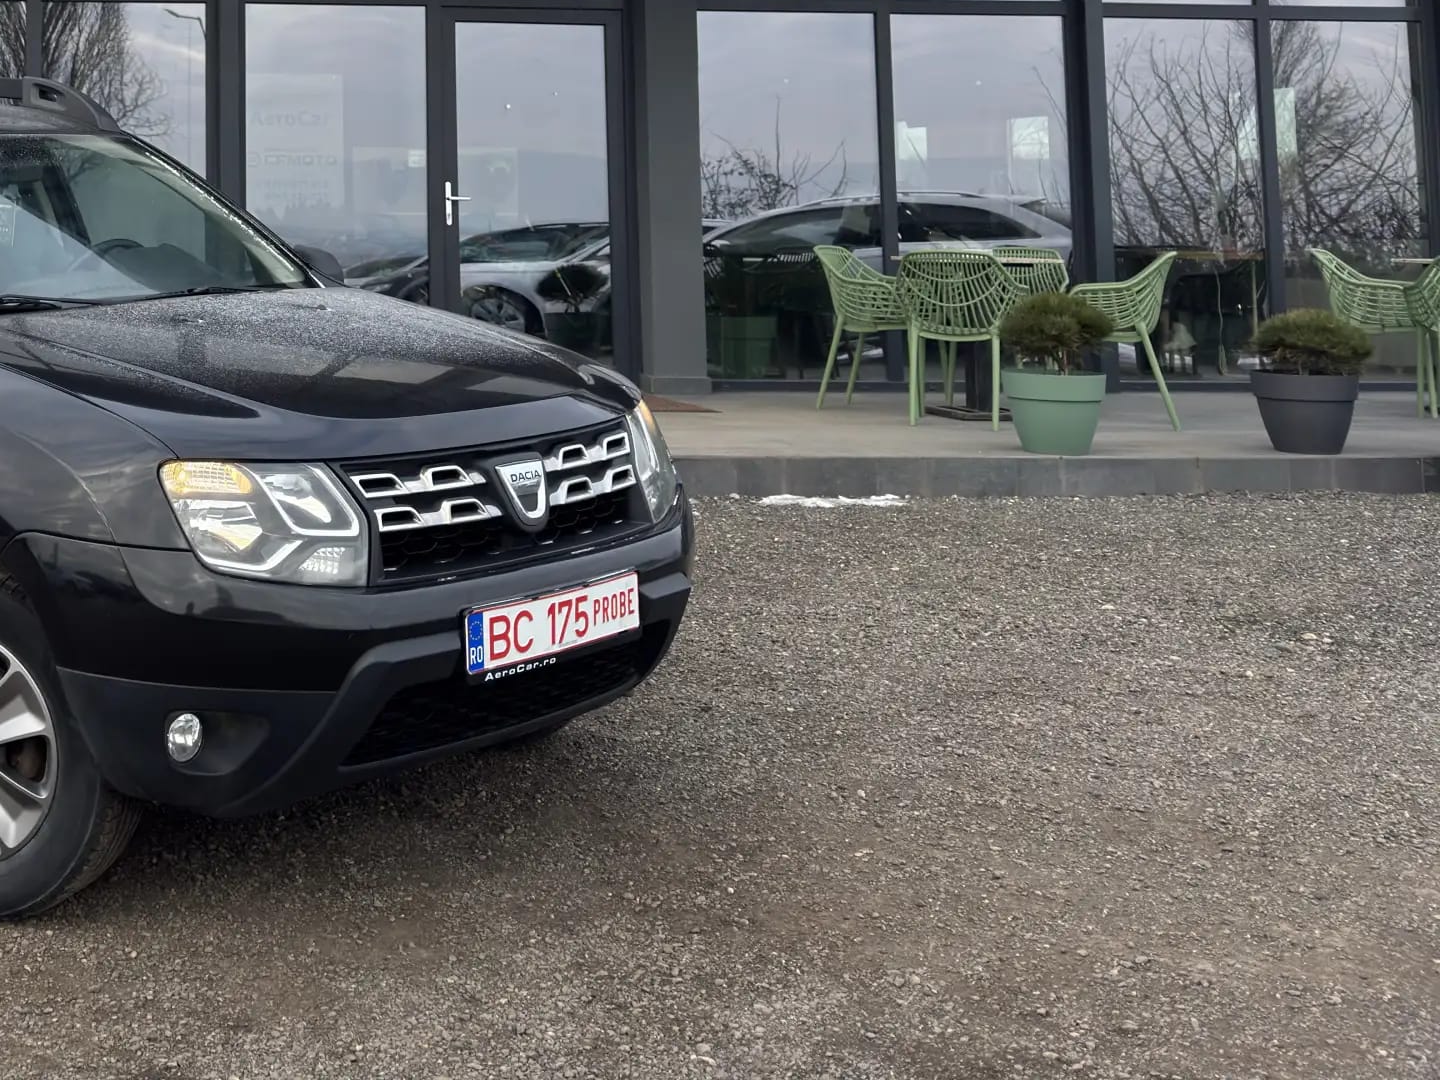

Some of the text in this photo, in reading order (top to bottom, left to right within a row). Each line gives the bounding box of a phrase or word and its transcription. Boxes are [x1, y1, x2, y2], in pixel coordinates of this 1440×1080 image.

[510, 469, 541, 483] DACIA
[470, 588, 636, 665] RO BC 175 PROBE
[484, 657, 557, 682] AeroCar.ro
